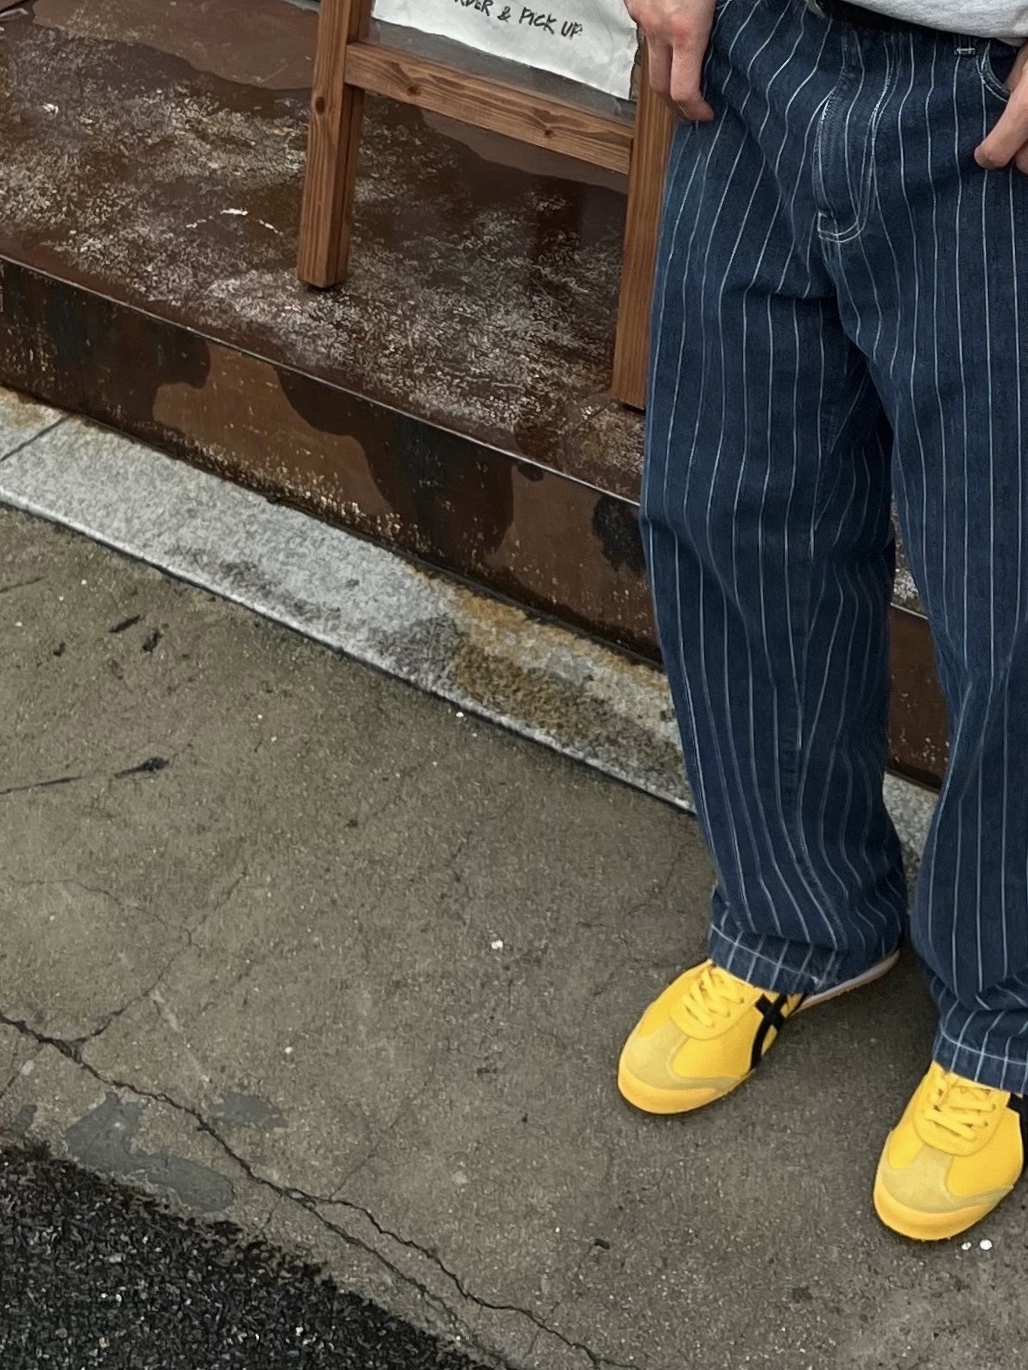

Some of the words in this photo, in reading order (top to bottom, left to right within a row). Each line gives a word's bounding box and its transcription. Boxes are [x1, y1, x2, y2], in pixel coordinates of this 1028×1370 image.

[497, 5, 511, 21] &
[519, 6, 557, 35] PICK
[560, 21, 583, 39] UP
